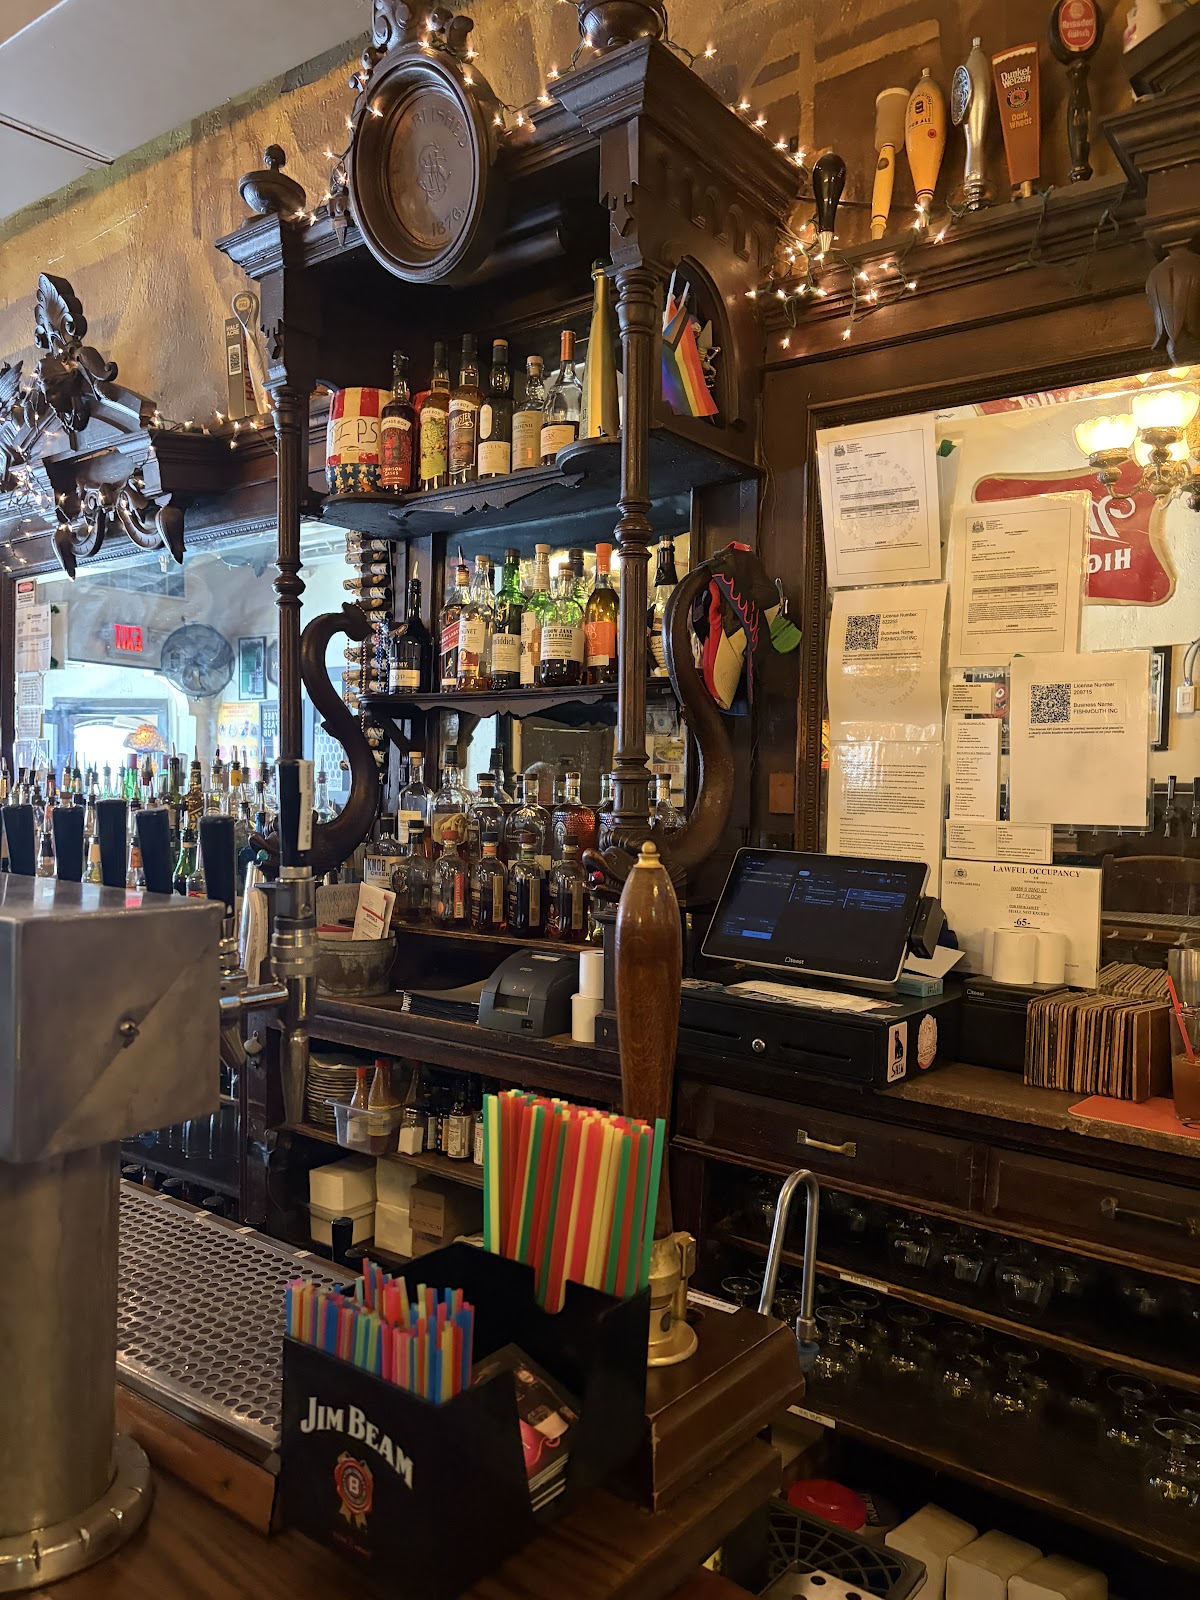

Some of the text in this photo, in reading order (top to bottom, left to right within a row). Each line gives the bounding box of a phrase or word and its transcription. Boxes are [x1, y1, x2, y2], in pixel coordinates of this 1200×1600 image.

[1011, 111, 1029, 121] Dark
[1009, 117, 1032, 129] Wheat
[226, 323, 240, 331] HALF
[227, 329, 240, 337] ACRE
[368, 858, 386, 871] KNOB
[993, 865, 1081, 878] LAWFUL OCCUPANCY
[1014, 918, 1031, 927] -65-
[301, 1397, 414, 1490] JIM BEAM
